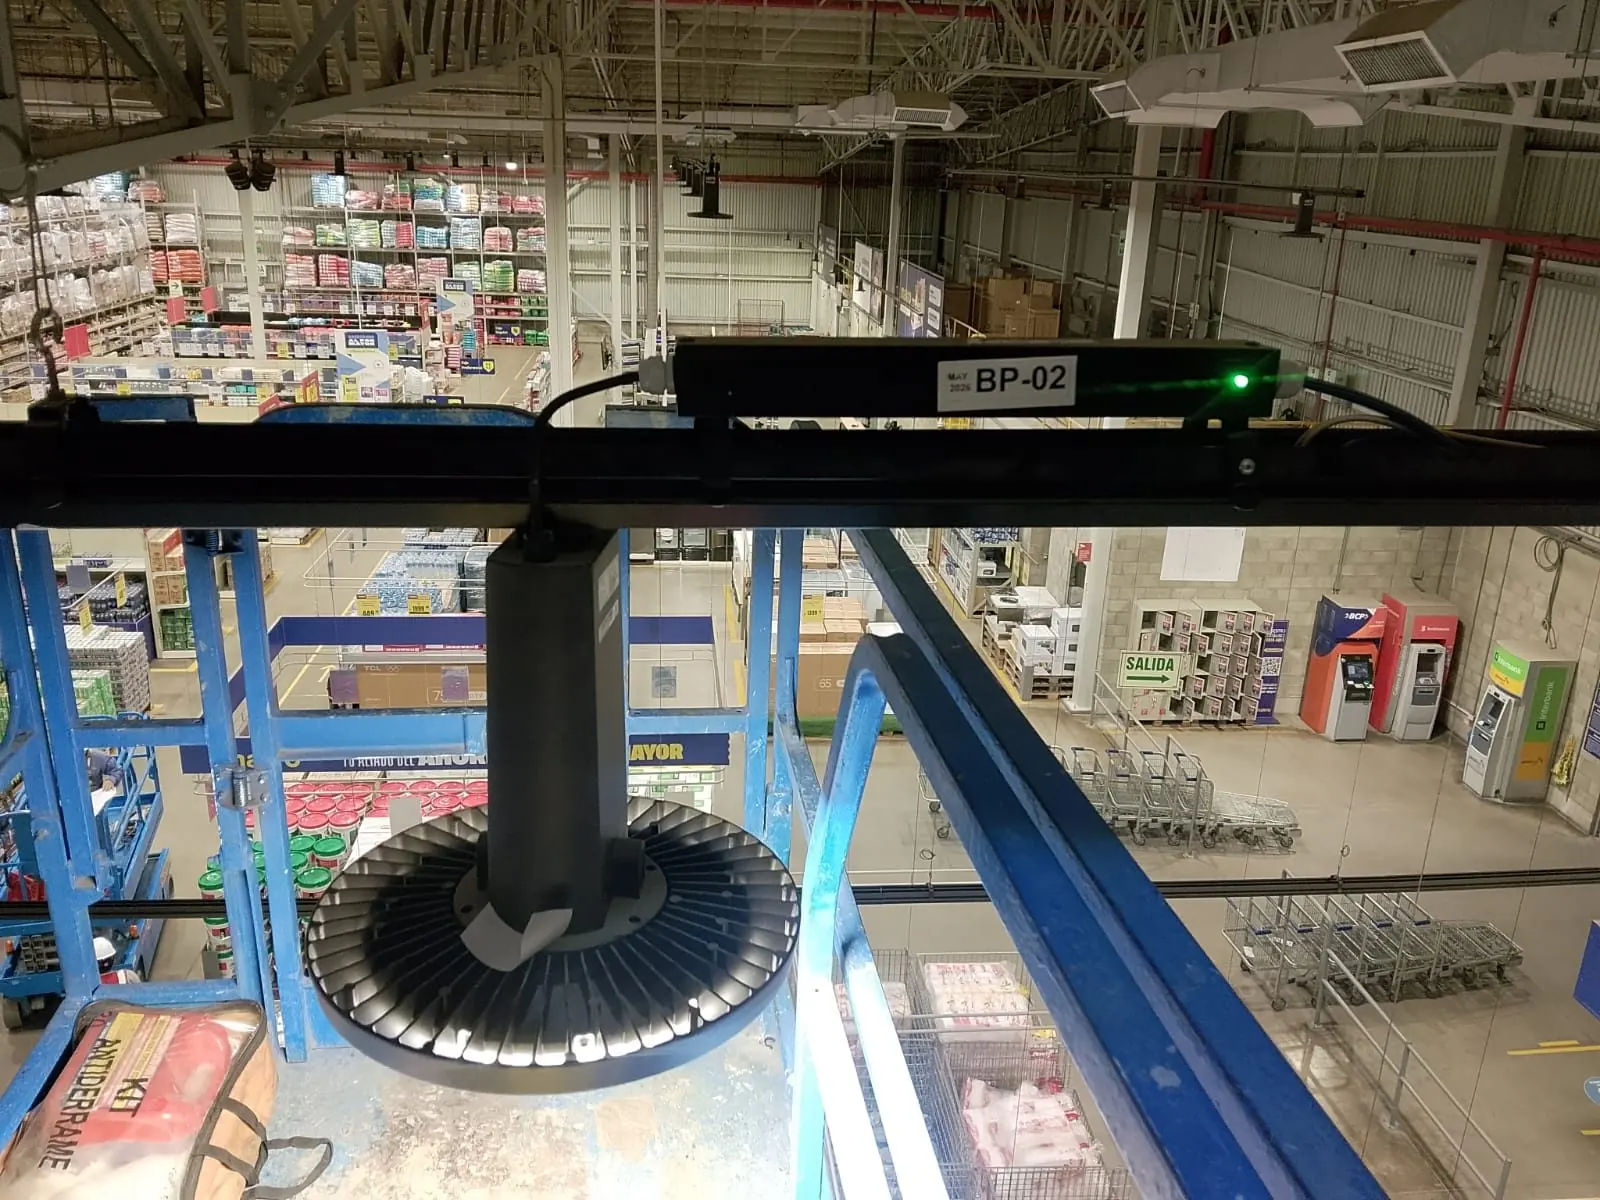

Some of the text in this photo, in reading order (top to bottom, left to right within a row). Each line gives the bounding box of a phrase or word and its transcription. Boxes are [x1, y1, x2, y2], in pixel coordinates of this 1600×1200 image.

[976, 365, 1066, 392] BP-02
[1126, 656, 1174, 672] SALIDA
[629, 743, 684, 760] AYOR
[38, 1037, 121, 1172] ANTIDERRAME
[109, 1077, 149, 1118] KIT
